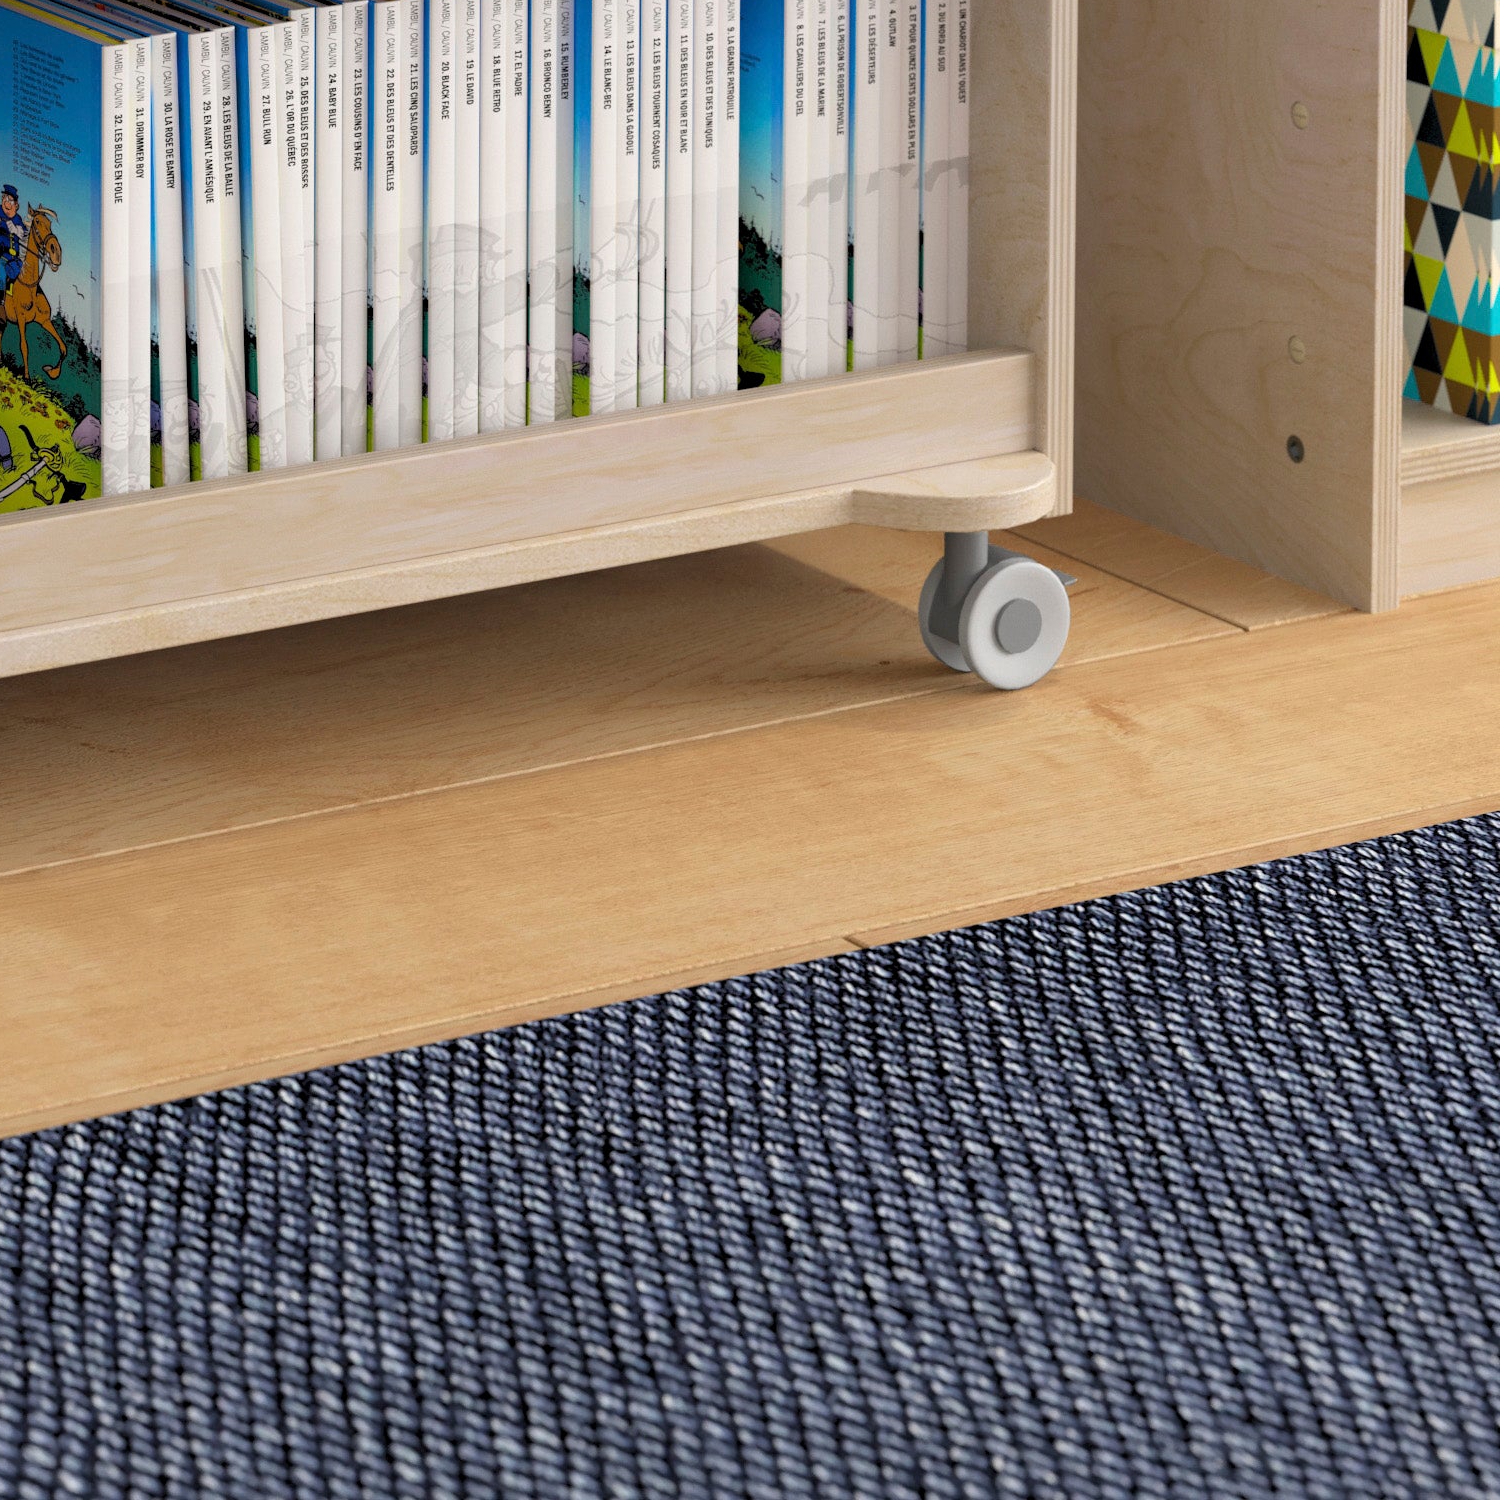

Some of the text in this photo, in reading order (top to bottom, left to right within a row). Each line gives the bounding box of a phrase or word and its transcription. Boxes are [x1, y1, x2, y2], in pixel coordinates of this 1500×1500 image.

[837, 15, 845, 23] 6.
[889, 9, 896, 17] 4.
[727, 27, 734, 35] 9.
[727, 36, 734, 45] LA
[796, 24, 803, 33] 8.
[837, 24, 845, 33] LA
[868, 23, 876, 37] LES
[220, 32, 230, 58] LAMBIL
[114, 49, 123, 76] LAMBIL
[514, 50, 522, 97] 17. EL PADRE
[561, 43, 569, 100] 15. RUMBERLEY
[817, 67, 825, 78] DE
[837, 63, 844, 73] DE
[868, 38, 877, 85] DÉSERTEURS
[221, 64, 231, 90] CAUVIN
[300, 77, 308, 89] 25.
[354, 69, 362, 81] 23.
[466, 60, 474, 105] 19. LE DAVID
[493, 55, 501, 113] 18. BLUE RETRO
[543, 49, 551, 118] 16. BRONCO BENNY
[603, 45, 612, 110] 14. LE BLANC-BEC
[652, 66, 660, 89] BLEUS
[817, 78, 825, 87] LA
[114, 83, 123, 108] CAUVIN
[285, 90, 294, 103] 26.
[300, 90, 308, 105] DES
[328, 73, 337, 128] 24. BABY BLUE
[354, 82, 362, 96] LES
[441, 61, 449, 120] 20. BLACK FACE
[626, 40, 634, 156] 13. LES BLEUS DANS LA GADOUE
[680, 35, 688, 153] 11. DES BLEUS EN NOIR ET BLANC
[704, 32, 713, 148] 10. DES BLEUS ET DES TUNIQUES
[726, 77, 734, 120] PATROUILLE
[796, 88, 803, 99] DU
[203, 101, 212, 113] 29.
[222, 96, 231, 108] 28.
[409, 63, 418, 156] 21. LES CINQ SALOPARDS
[652, 90, 660, 128] TOURNENT
[817, 88, 825, 117] MARINE
[114, 114, 123, 127] 32.
[203, 115, 212, 125] EN
[222, 110, 232, 124] LES
[262, 95, 271, 145] 27. BULL RUN
[300, 107, 308, 131] BLEUS
[354, 98, 362, 131] COUSINS
[114, 128, 123, 142] LES
[203, 127, 213, 151] AVANT
[223, 125, 232, 150] BLEUS
[286, 123, 295, 135] DU
[301, 132, 308, 141] ET
[386, 69, 395, 192] 22. DES BLEUS ET DES DENTELLES
[136, 107, 145, 179] 31. DRUMMER BOY
[164, 102, 174, 189] 30. LA ROSE DE BANTRY
[286, 136, 297, 167] QUÉBEC
[651, 130, 660, 169] COSAQUES
[114, 144, 123, 169] BLEUS
[224, 151, 233, 161] DE
[224, 163, 233, 172] LA
[354, 152, 362, 171] FACE
[114, 171, 123, 181] EN
[224, 173, 233, 197] BALLE
[114, 182, 123, 203] FOLIE
